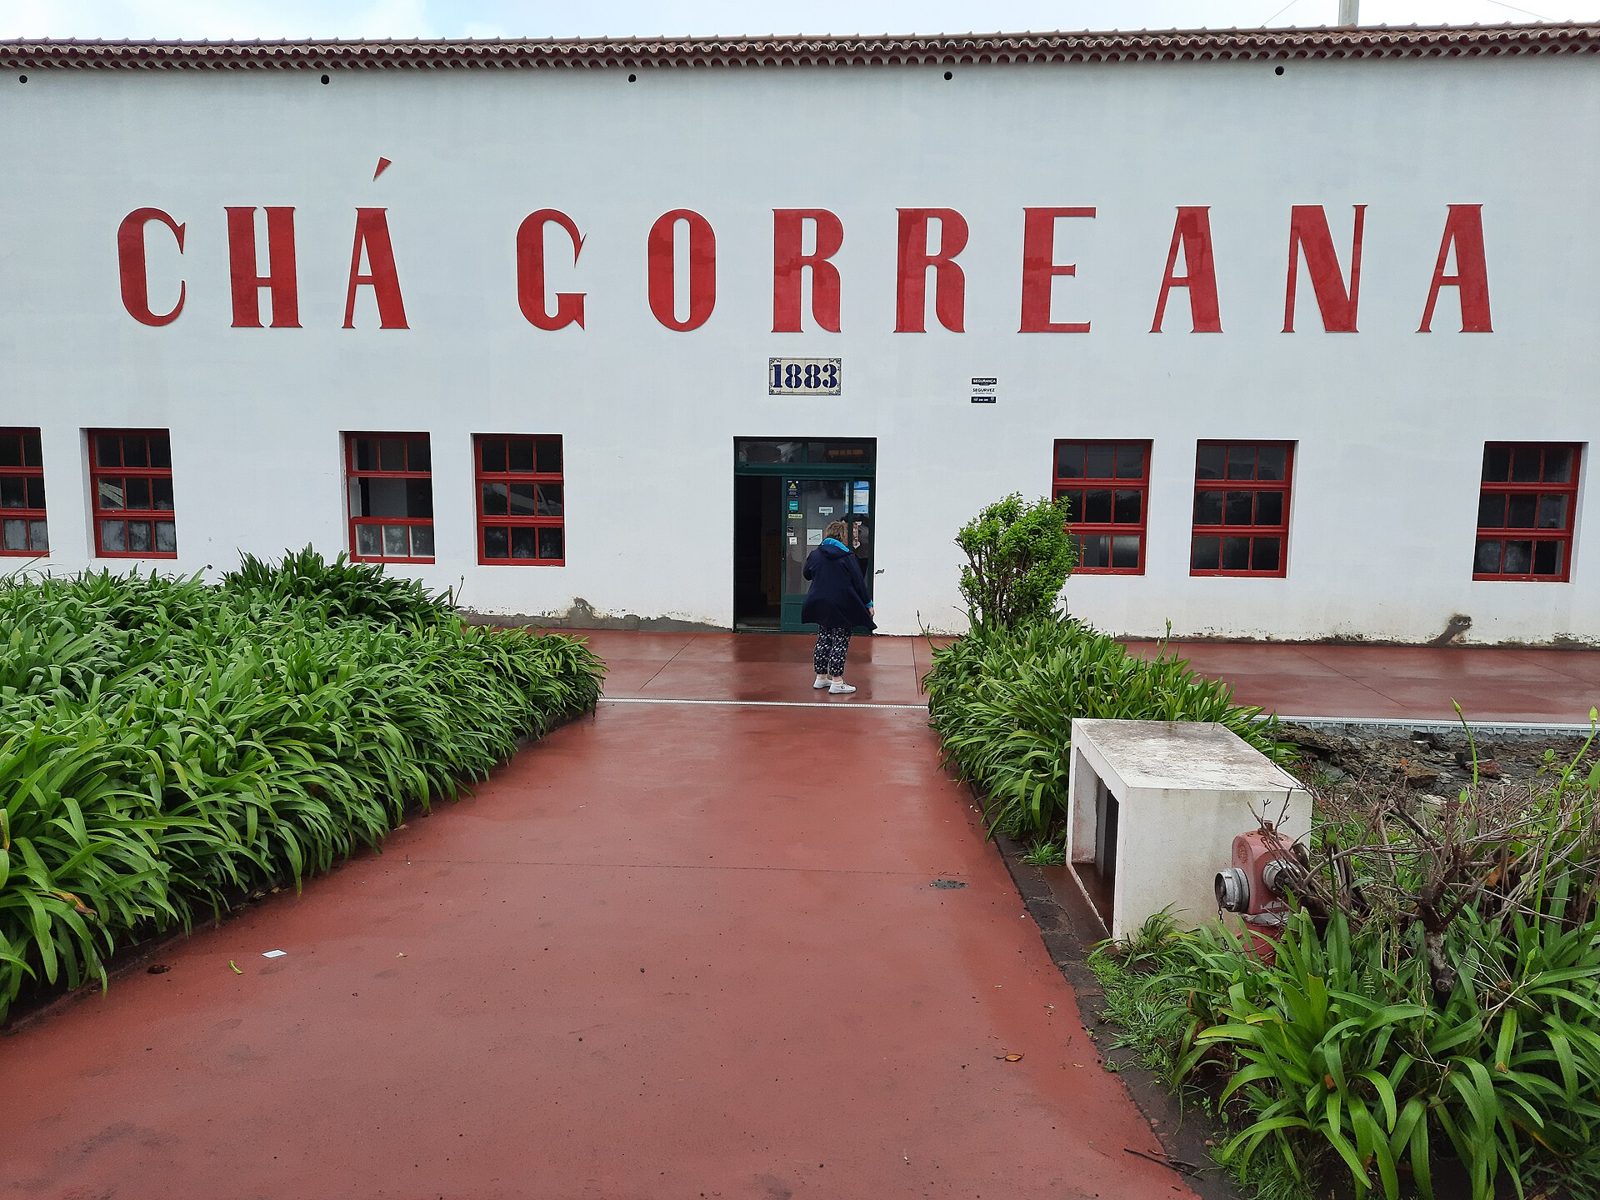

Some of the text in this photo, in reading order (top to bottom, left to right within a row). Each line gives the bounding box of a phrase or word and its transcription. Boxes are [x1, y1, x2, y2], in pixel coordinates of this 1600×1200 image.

[118, 158, 1492, 333] CHÁ GORREANA
[772, 363, 838, 389] 1883
